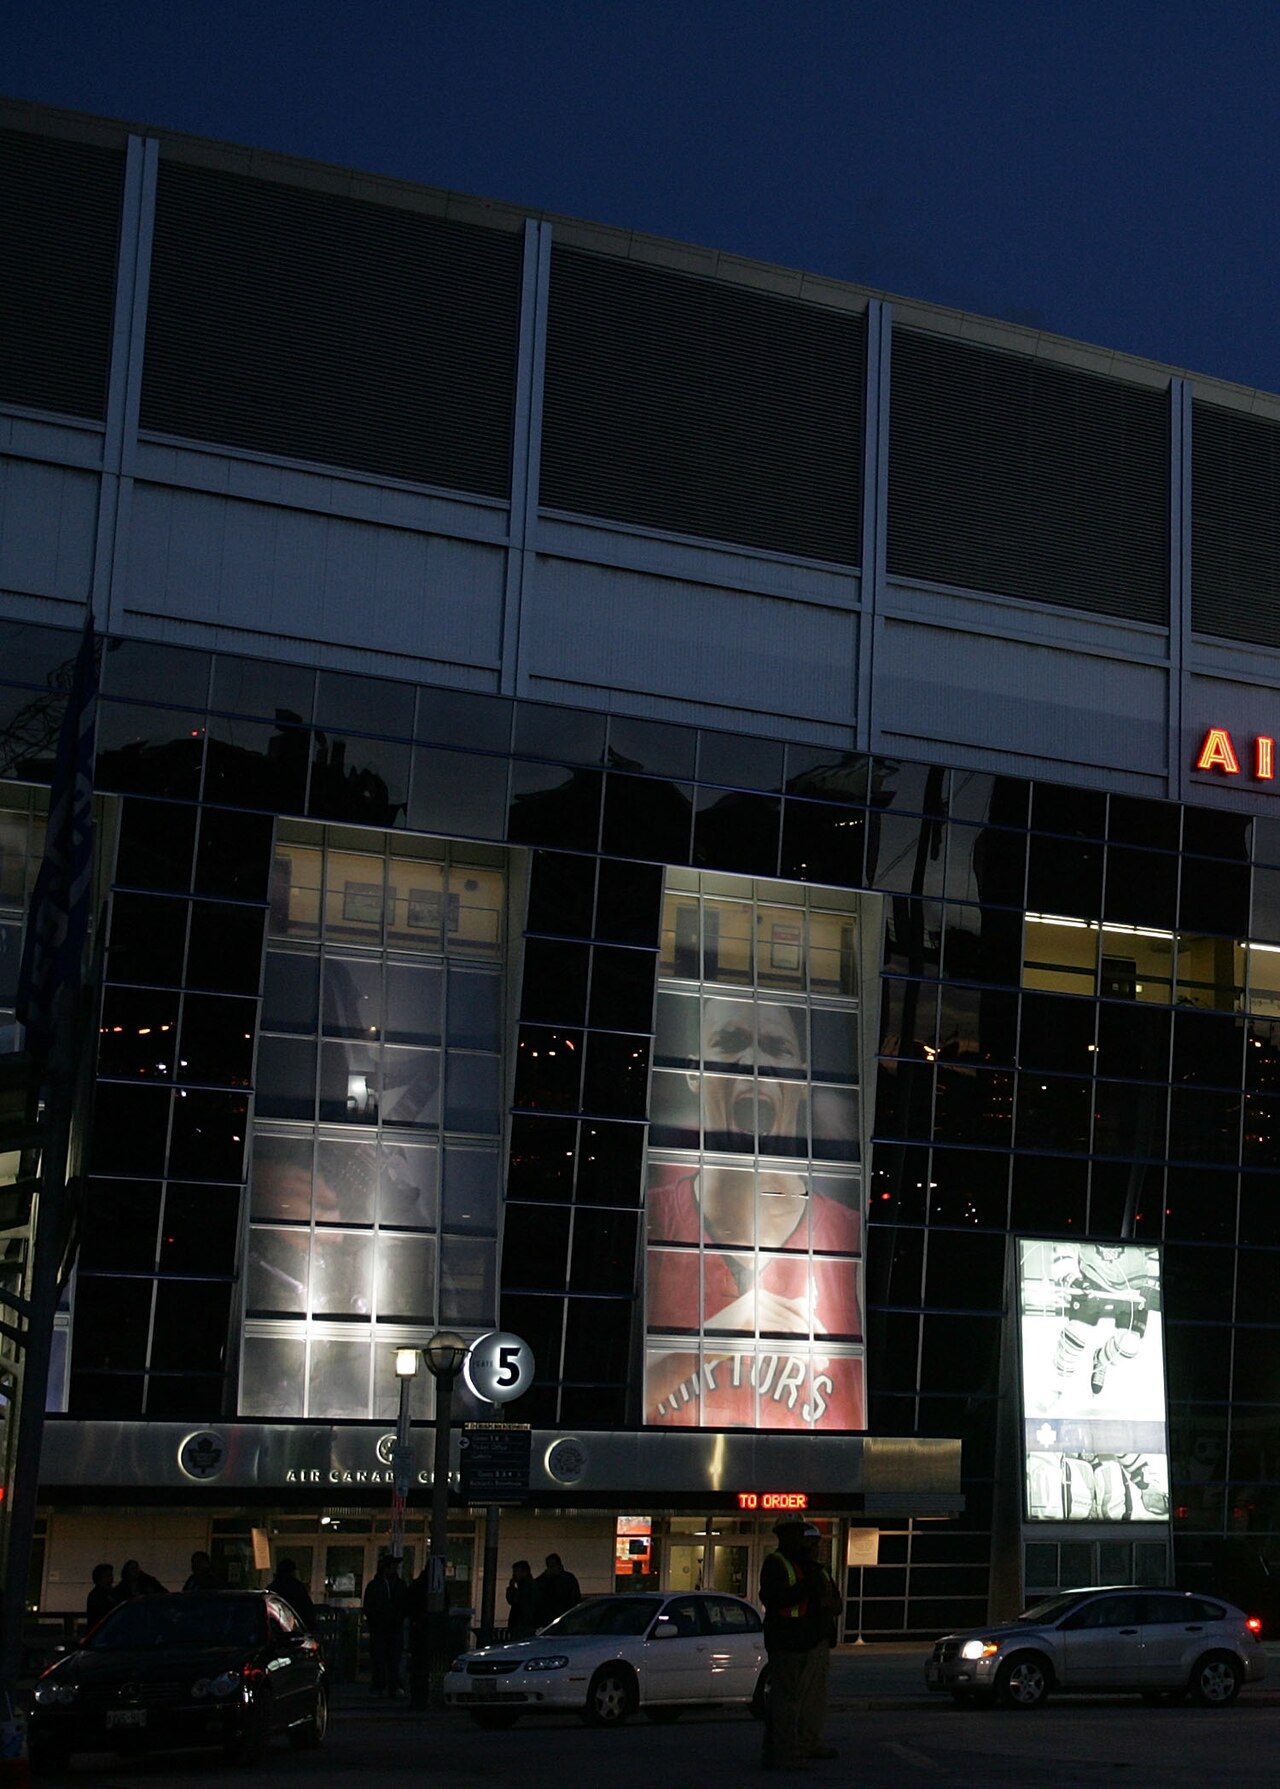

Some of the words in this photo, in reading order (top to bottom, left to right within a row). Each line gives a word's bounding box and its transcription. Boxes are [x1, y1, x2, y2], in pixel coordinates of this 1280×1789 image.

[497, 1347, 521, 1387] 5
[286, 1469, 321, 1482] AIR
[329, 1469, 396, 1483] CANAD
[739, 1494, 757, 1508] TO
[762, 1494, 807, 1509] ORDER
